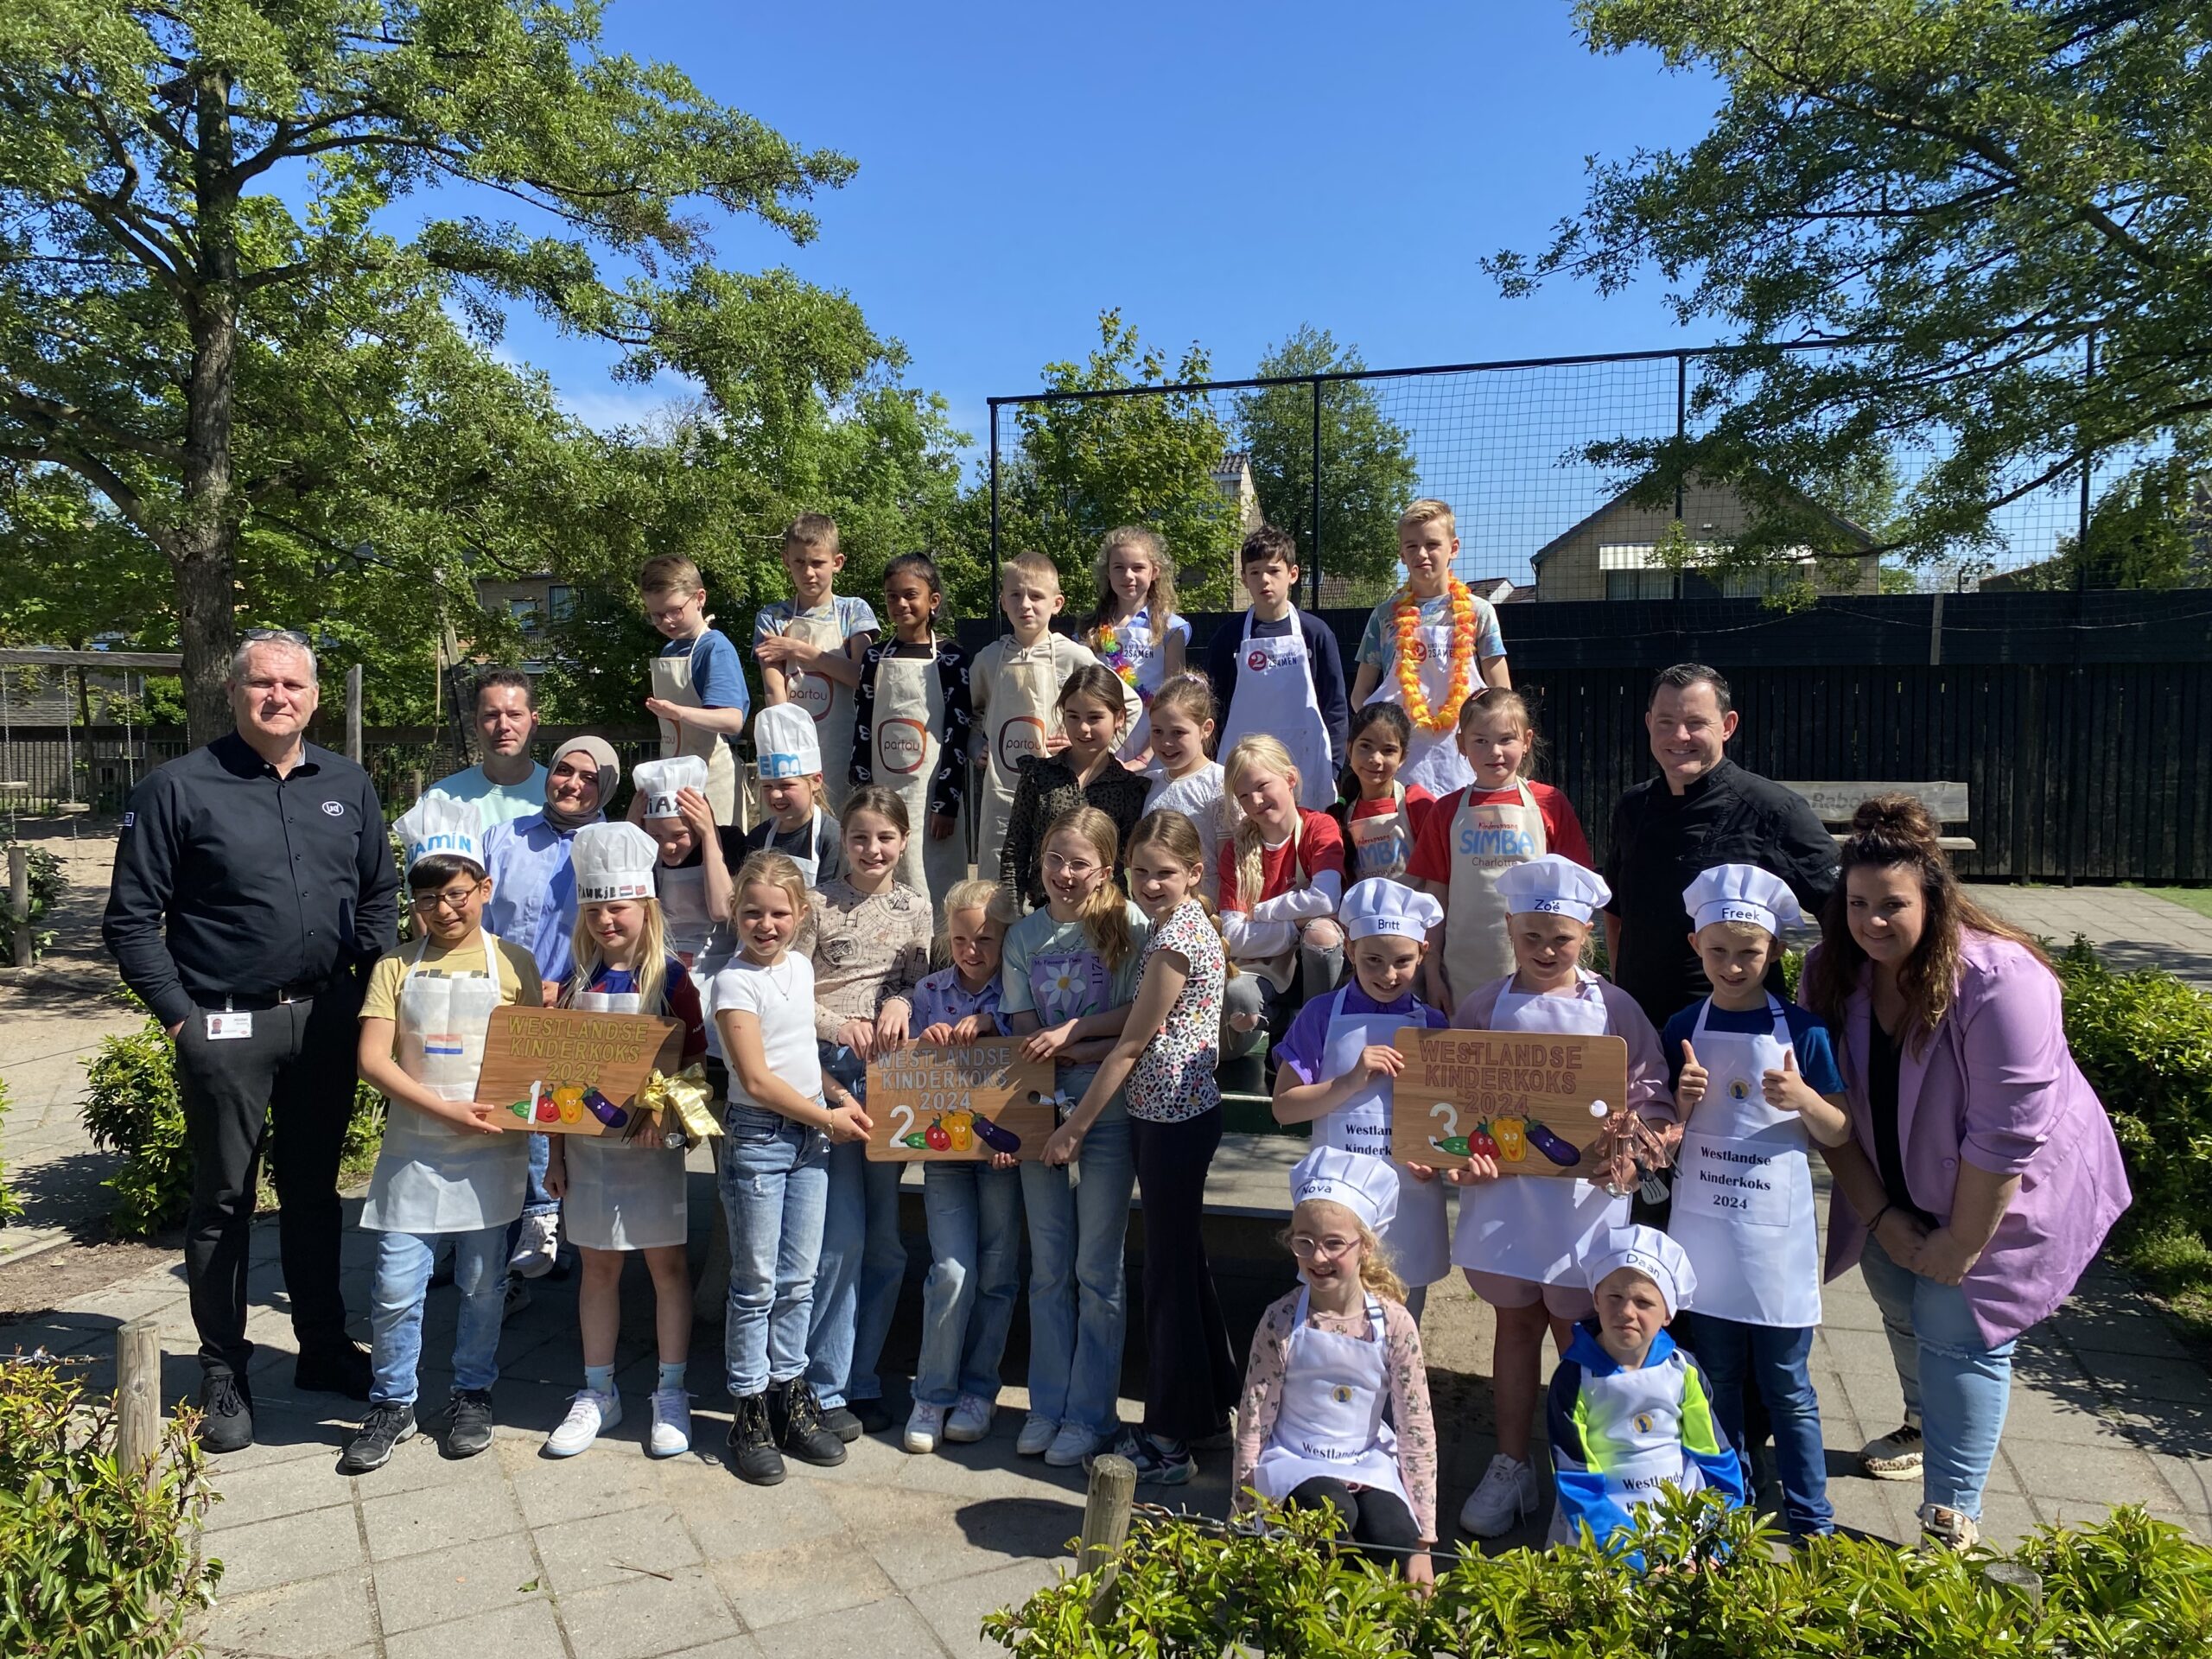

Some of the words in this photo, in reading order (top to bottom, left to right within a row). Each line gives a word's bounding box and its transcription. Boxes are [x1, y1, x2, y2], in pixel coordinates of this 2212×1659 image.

[1124, 649, 1154, 658] 2SAMEN
[1428, 649, 1454, 658] 2SAME
[789, 689, 828, 702] partou
[884, 739, 920, 752] partou
[1005, 738, 1042, 751] partou
[1811, 791, 1872, 810] Rabo
[1459, 829, 1535, 855] SIMBA
[1534, 899, 1560, 912] Zoë
[1721, 907, 1761, 923] Freek
[1377, 918, 1400, 931] Britt
[508, 1014, 650, 1042] WESTLANDSE
[510, 1037, 641, 1064] KINDERKOKS
[877, 1047, 1011, 1070] WESTLANDSE
[1419, 1039, 1583, 1070] WESTLANDSE
[545, 1061, 601, 1084] 2024
[881, 1068, 1008, 1090] KINDERKOKS
[1425, 1065, 1577, 1095] KINDERKOKS
[527, 1080, 542, 1124] 1
[918, 1090, 971, 1111] 2024
[1464, 1091, 1529, 1116] 2024
[889, 1104, 915, 1148] 2
[1345, 1124, 1392, 1136] Westlan
[1427, 1103, 1458, 1153] 3
[1344, 1143, 1392, 1156] Kinderk
[1700, 1146, 1771, 1166] Westlandse
[1301, 1184, 1332, 1194] Nova
[1700, 1169, 1771, 1191] Kinderkoks
[1713, 1194, 1748, 1210] 2024
[1625, 1253, 1660, 1279] Daan
[1302, 1441, 1360, 1459] Westland
[1622, 1471, 1684, 1491] Westlnds
